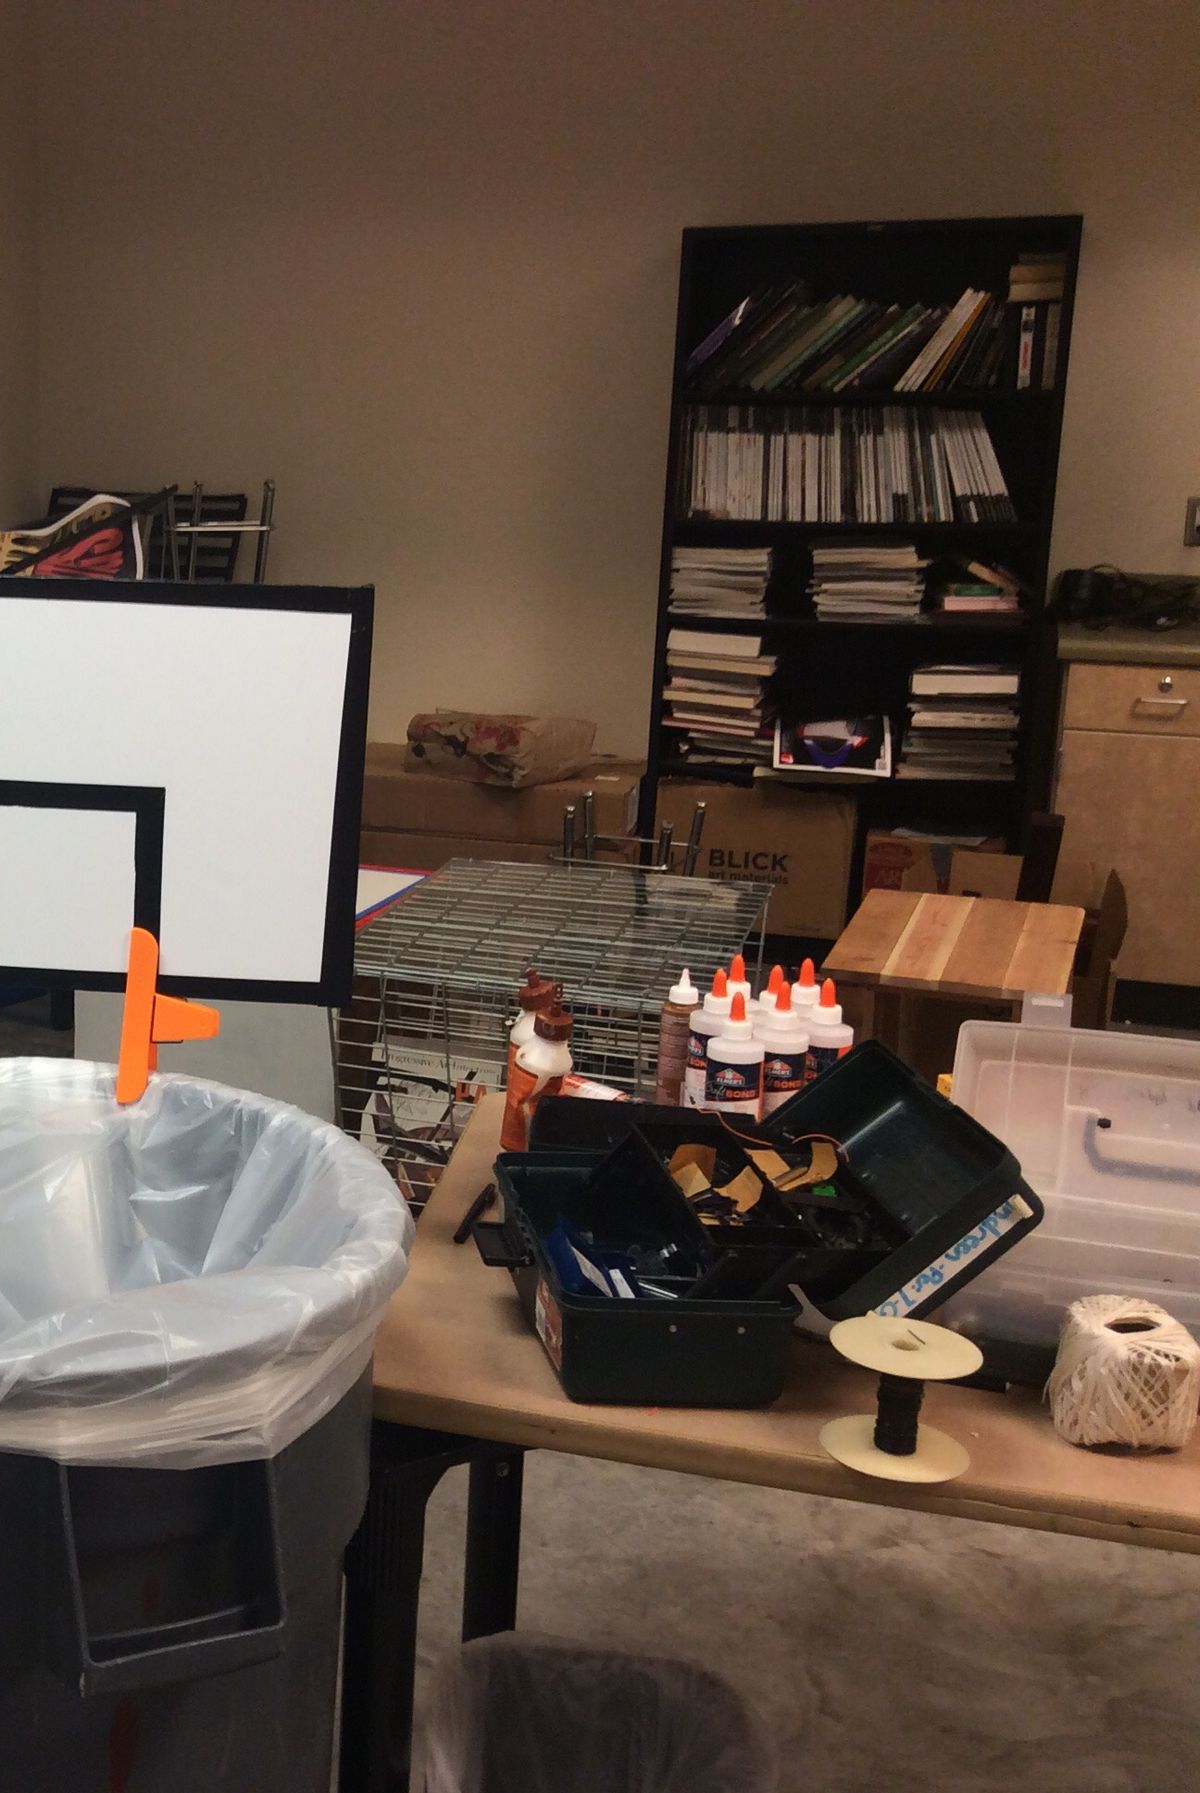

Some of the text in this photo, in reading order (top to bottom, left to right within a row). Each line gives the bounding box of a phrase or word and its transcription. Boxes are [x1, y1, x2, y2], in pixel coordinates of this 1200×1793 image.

[708, 848, 788, 872] BLICK
[708, 870, 788, 885] art materials
[380, 1051, 434, 1067] Pogressive
[716, 1077, 743, 1085] ELMER'S
